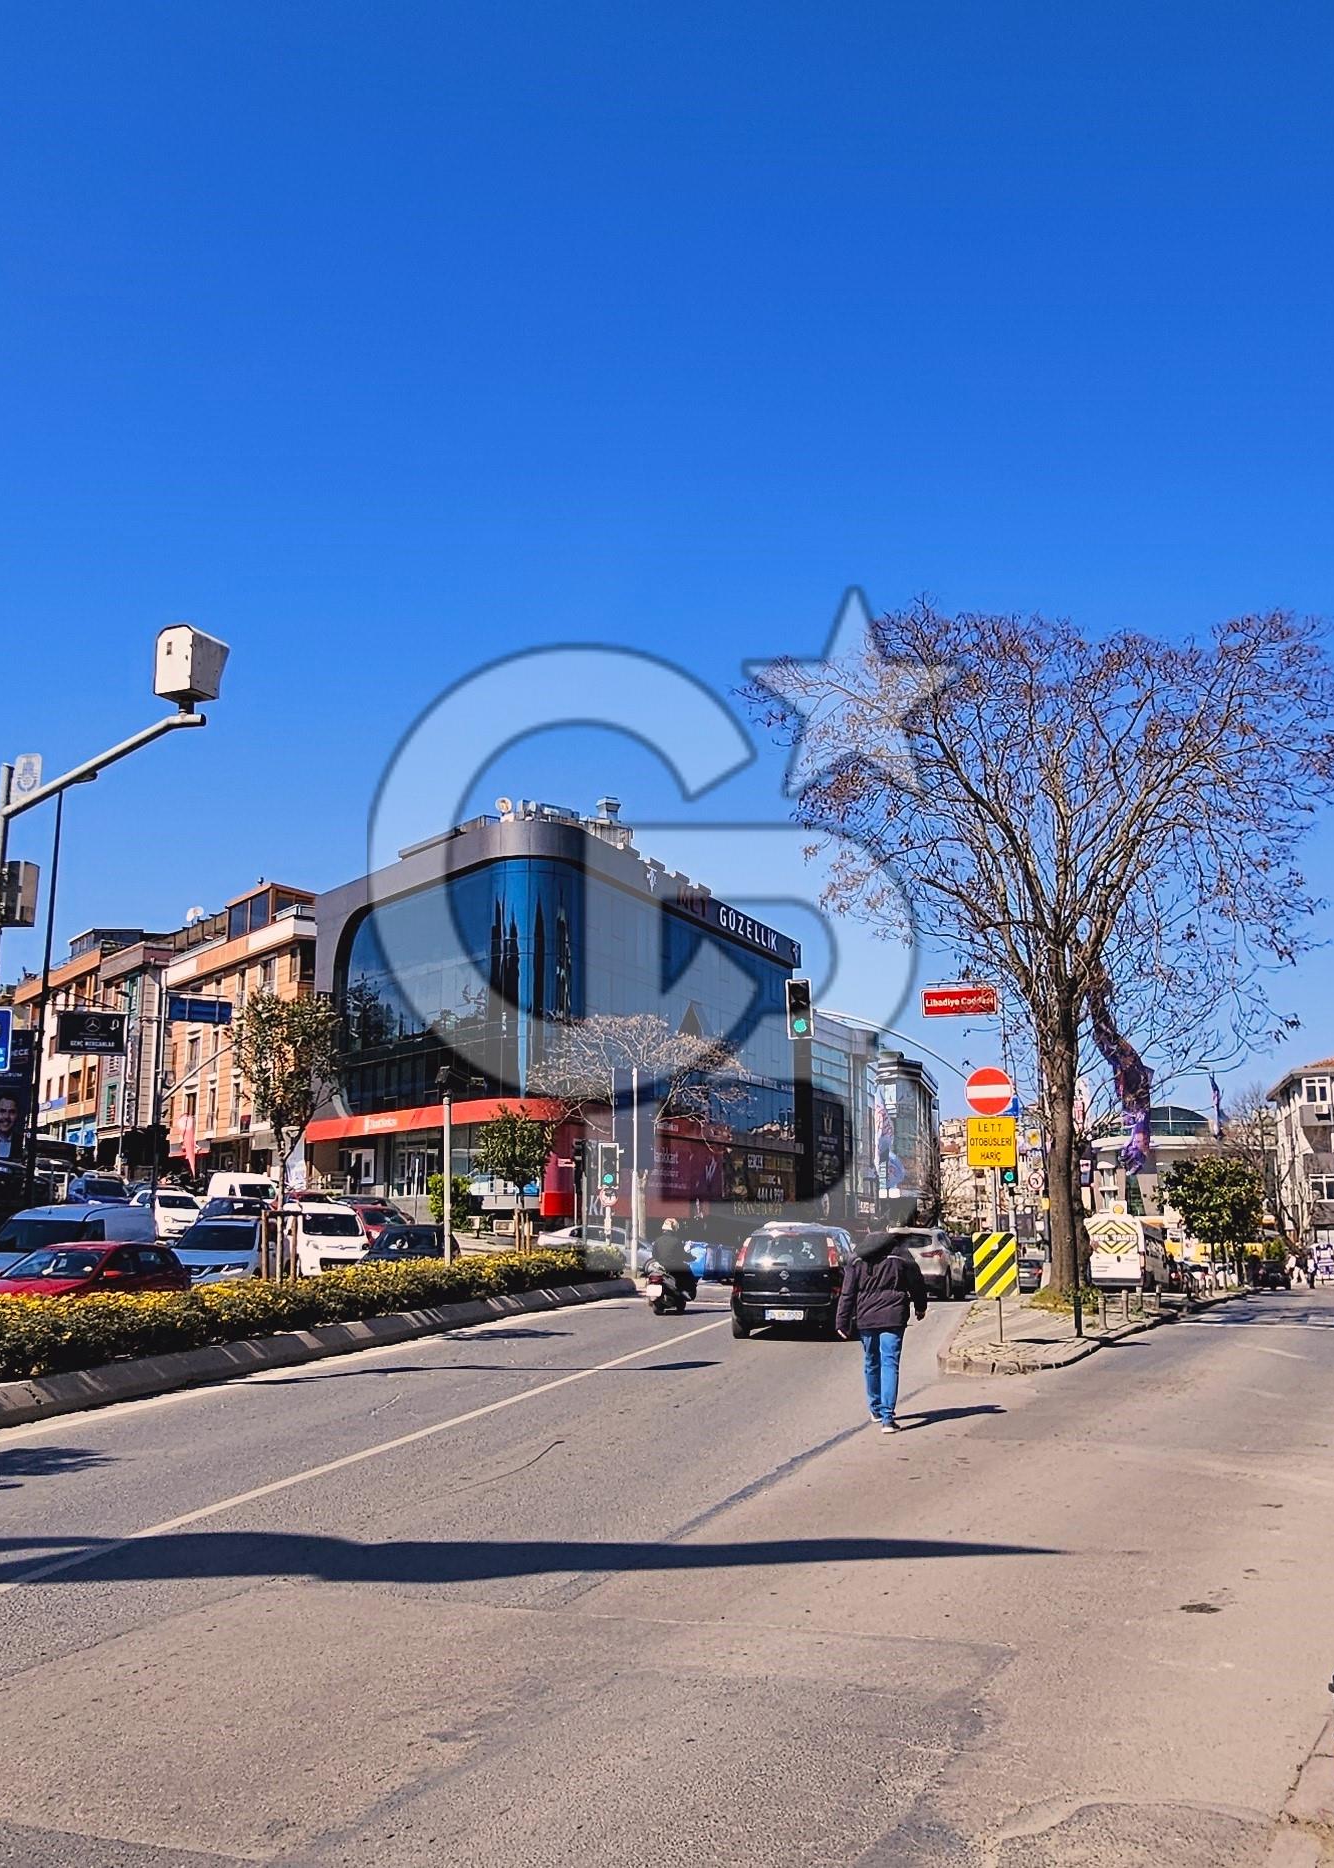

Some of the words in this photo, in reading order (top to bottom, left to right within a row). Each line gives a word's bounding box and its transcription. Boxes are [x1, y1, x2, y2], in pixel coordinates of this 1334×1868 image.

[719, 906, 778, 952] GÜZELLİK
[925, 997, 960, 1008] Libadiye
[969, 1136, 1012, 1147] OTOBÜSLERİ
[980, 1150, 1001, 1163] HARİÇ
